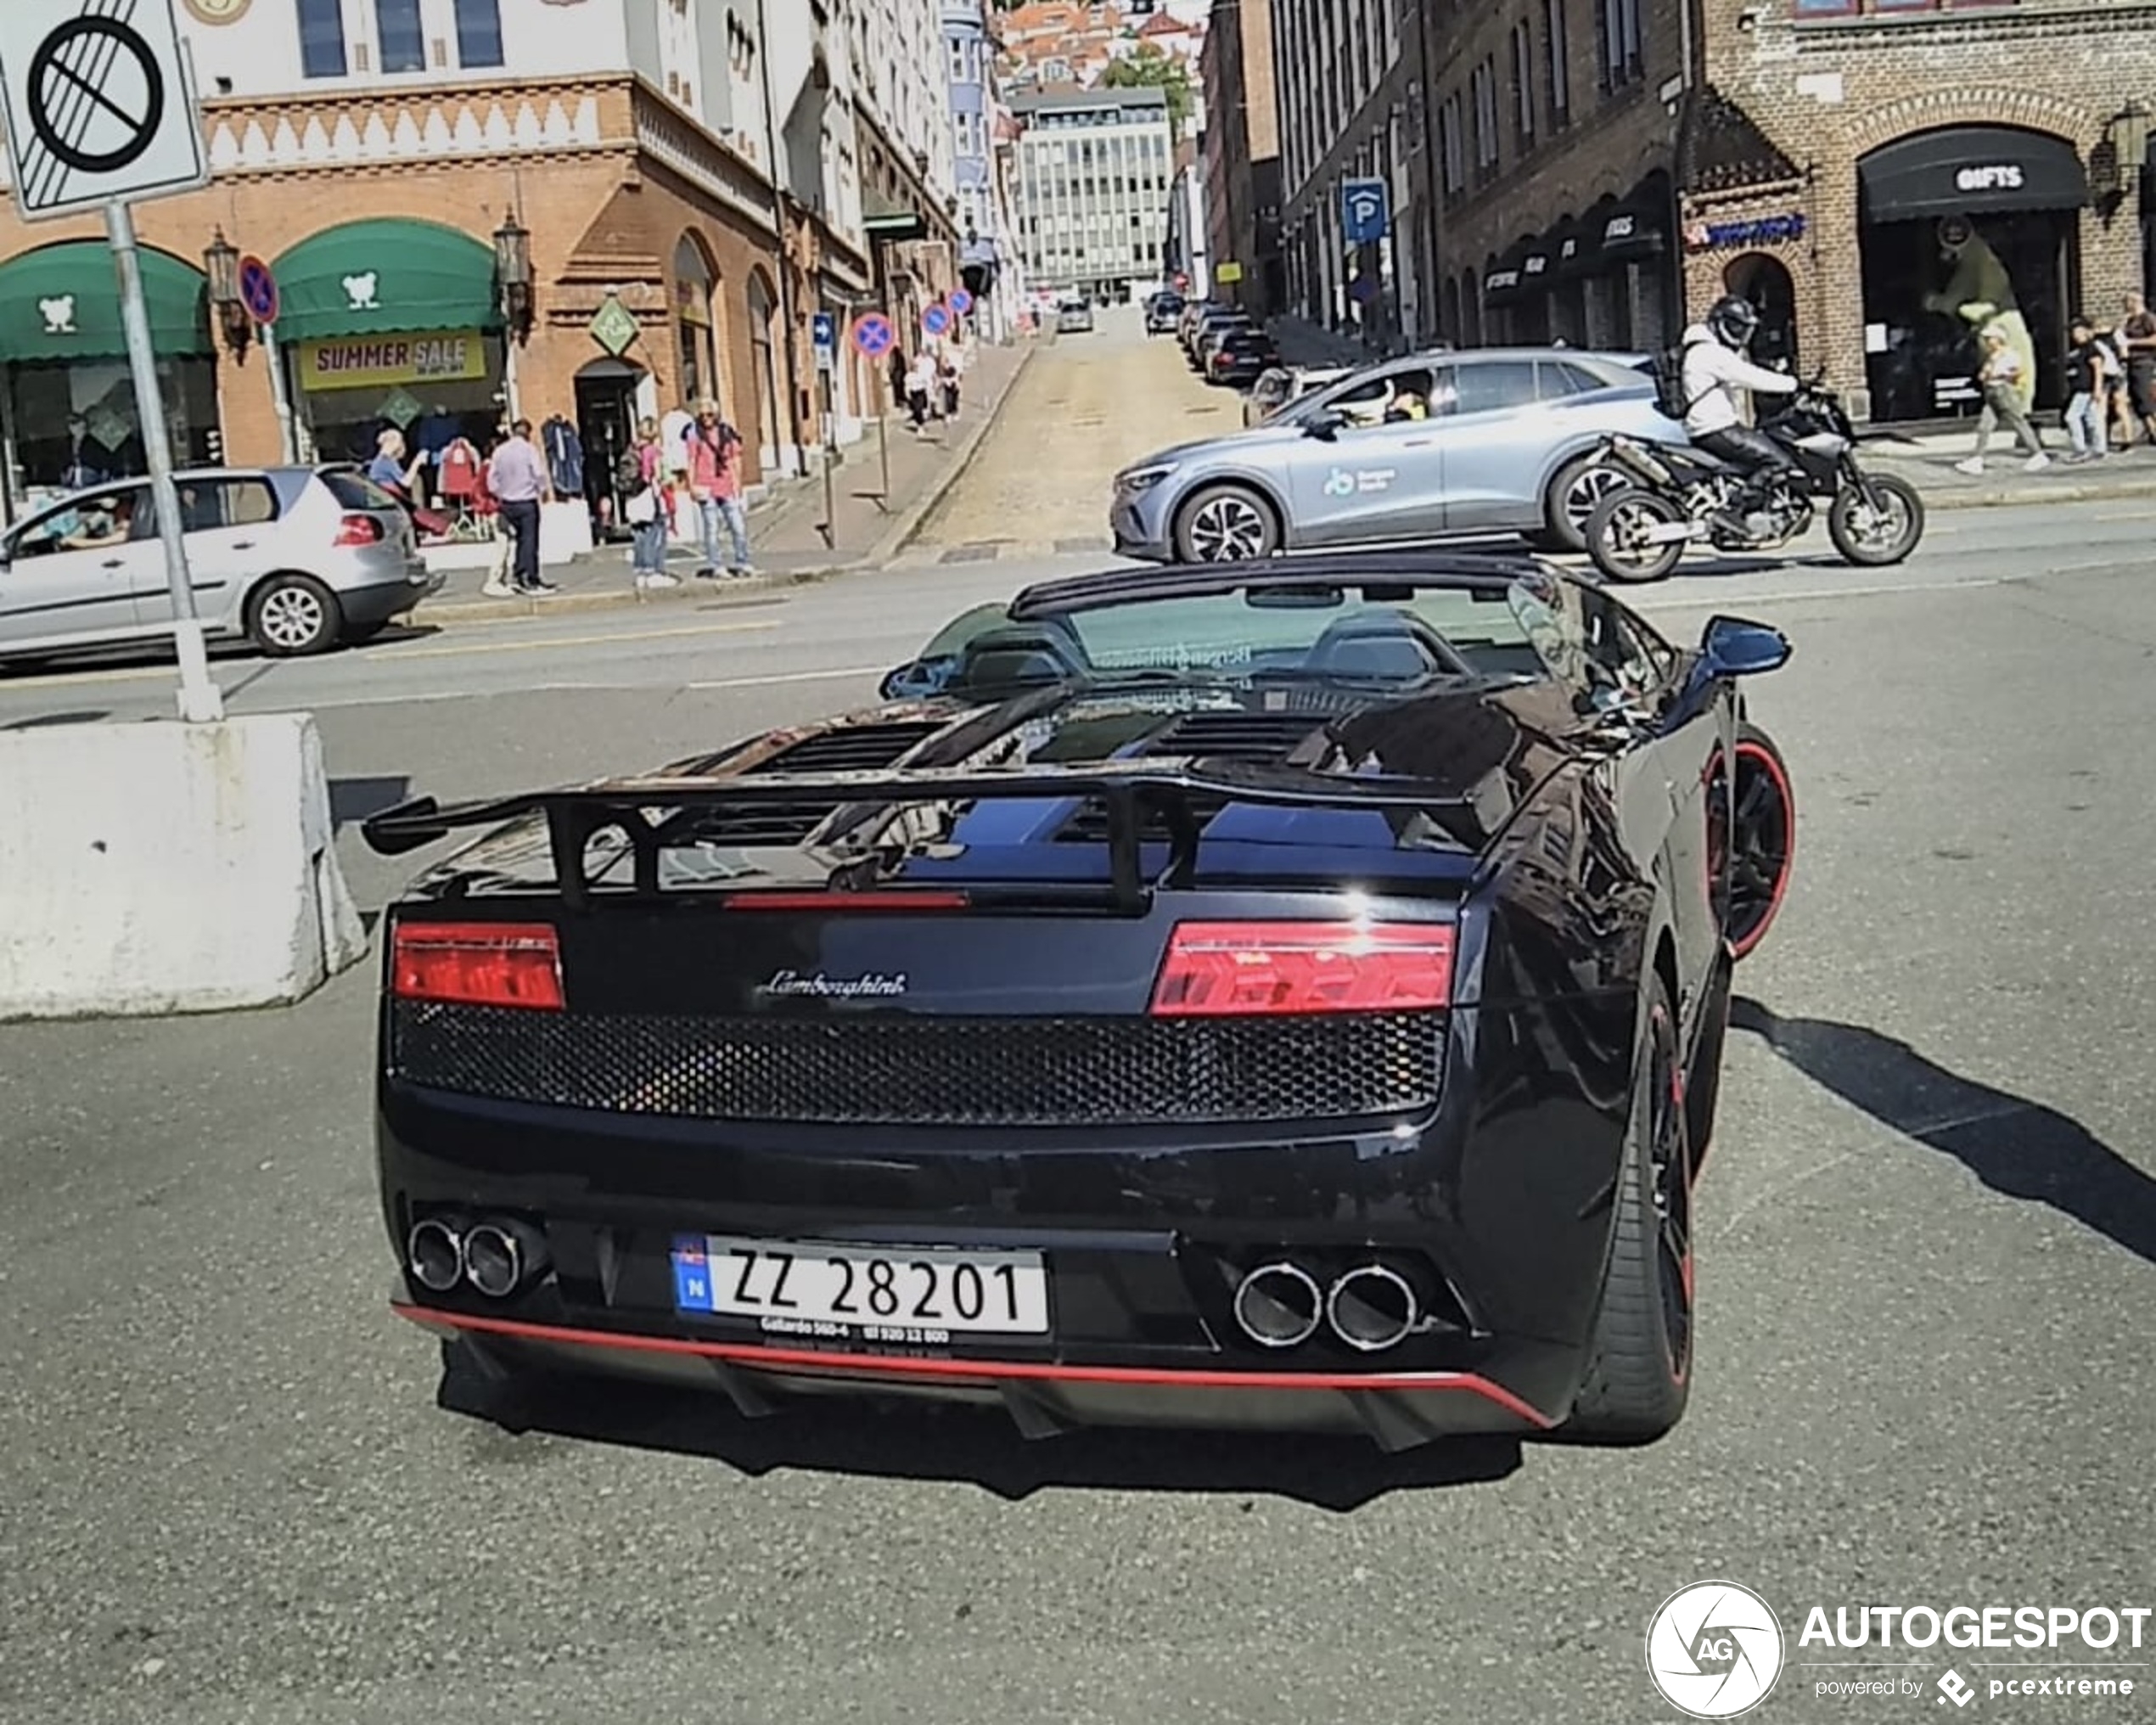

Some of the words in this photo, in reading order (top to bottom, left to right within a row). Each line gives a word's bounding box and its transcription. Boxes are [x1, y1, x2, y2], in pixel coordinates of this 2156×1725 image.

[1957, 166, 2024, 190] GIFTS
[1356, 201, 1375, 223] P
[316, 342, 410, 373] SUMMER
[414, 339, 466, 366] SALE
[755, 970, 907, 1000] Lamborghini
[688, 1278, 705, 1297] N
[729, 1248, 798, 1308] ZZ
[826, 1256, 1018, 1321] 28201
